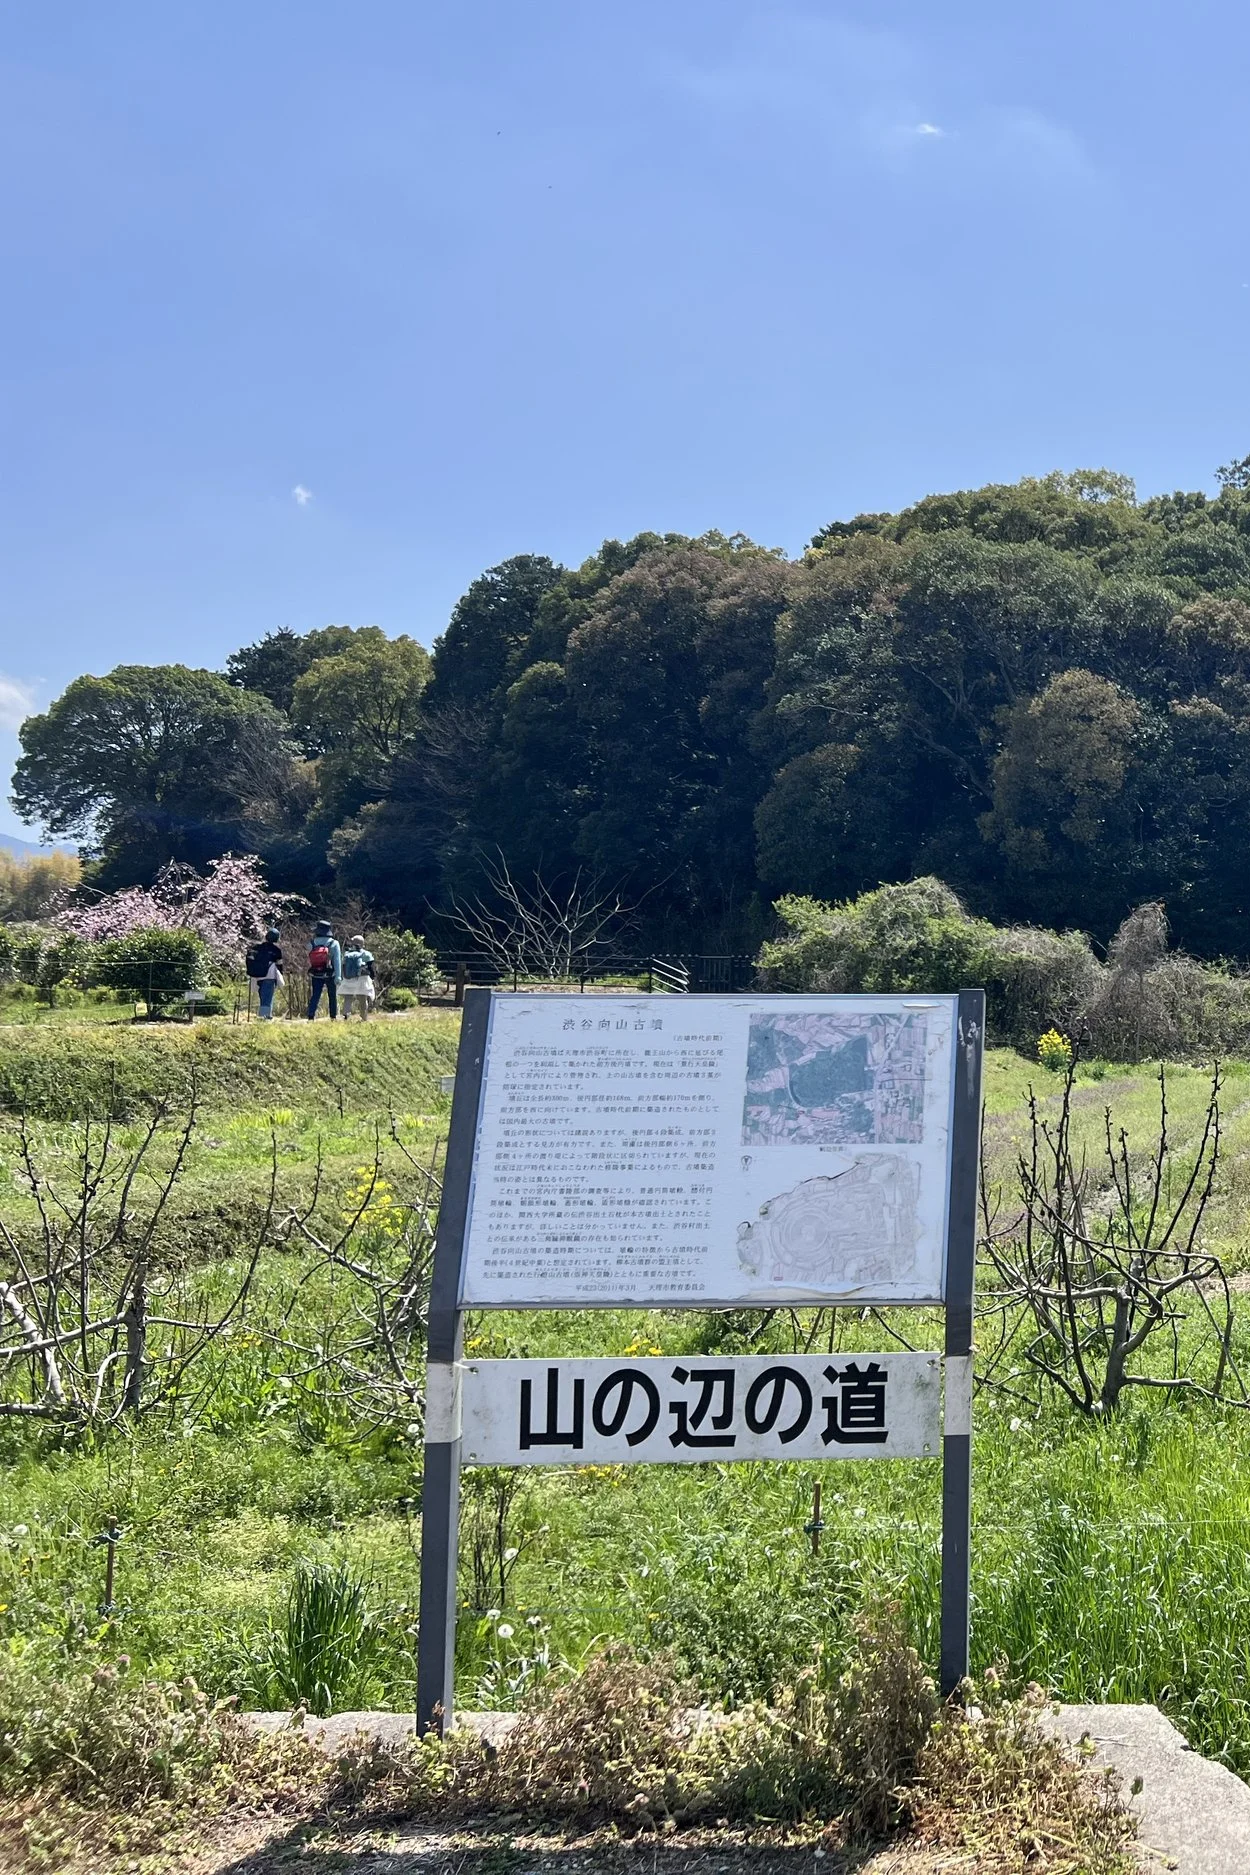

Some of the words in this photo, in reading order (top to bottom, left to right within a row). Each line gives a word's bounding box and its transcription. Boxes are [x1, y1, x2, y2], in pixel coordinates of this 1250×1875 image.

[562, 1018, 663, 1031] 渋谷向山古墳
[519, 1362, 889, 1450] 山の辺の道
